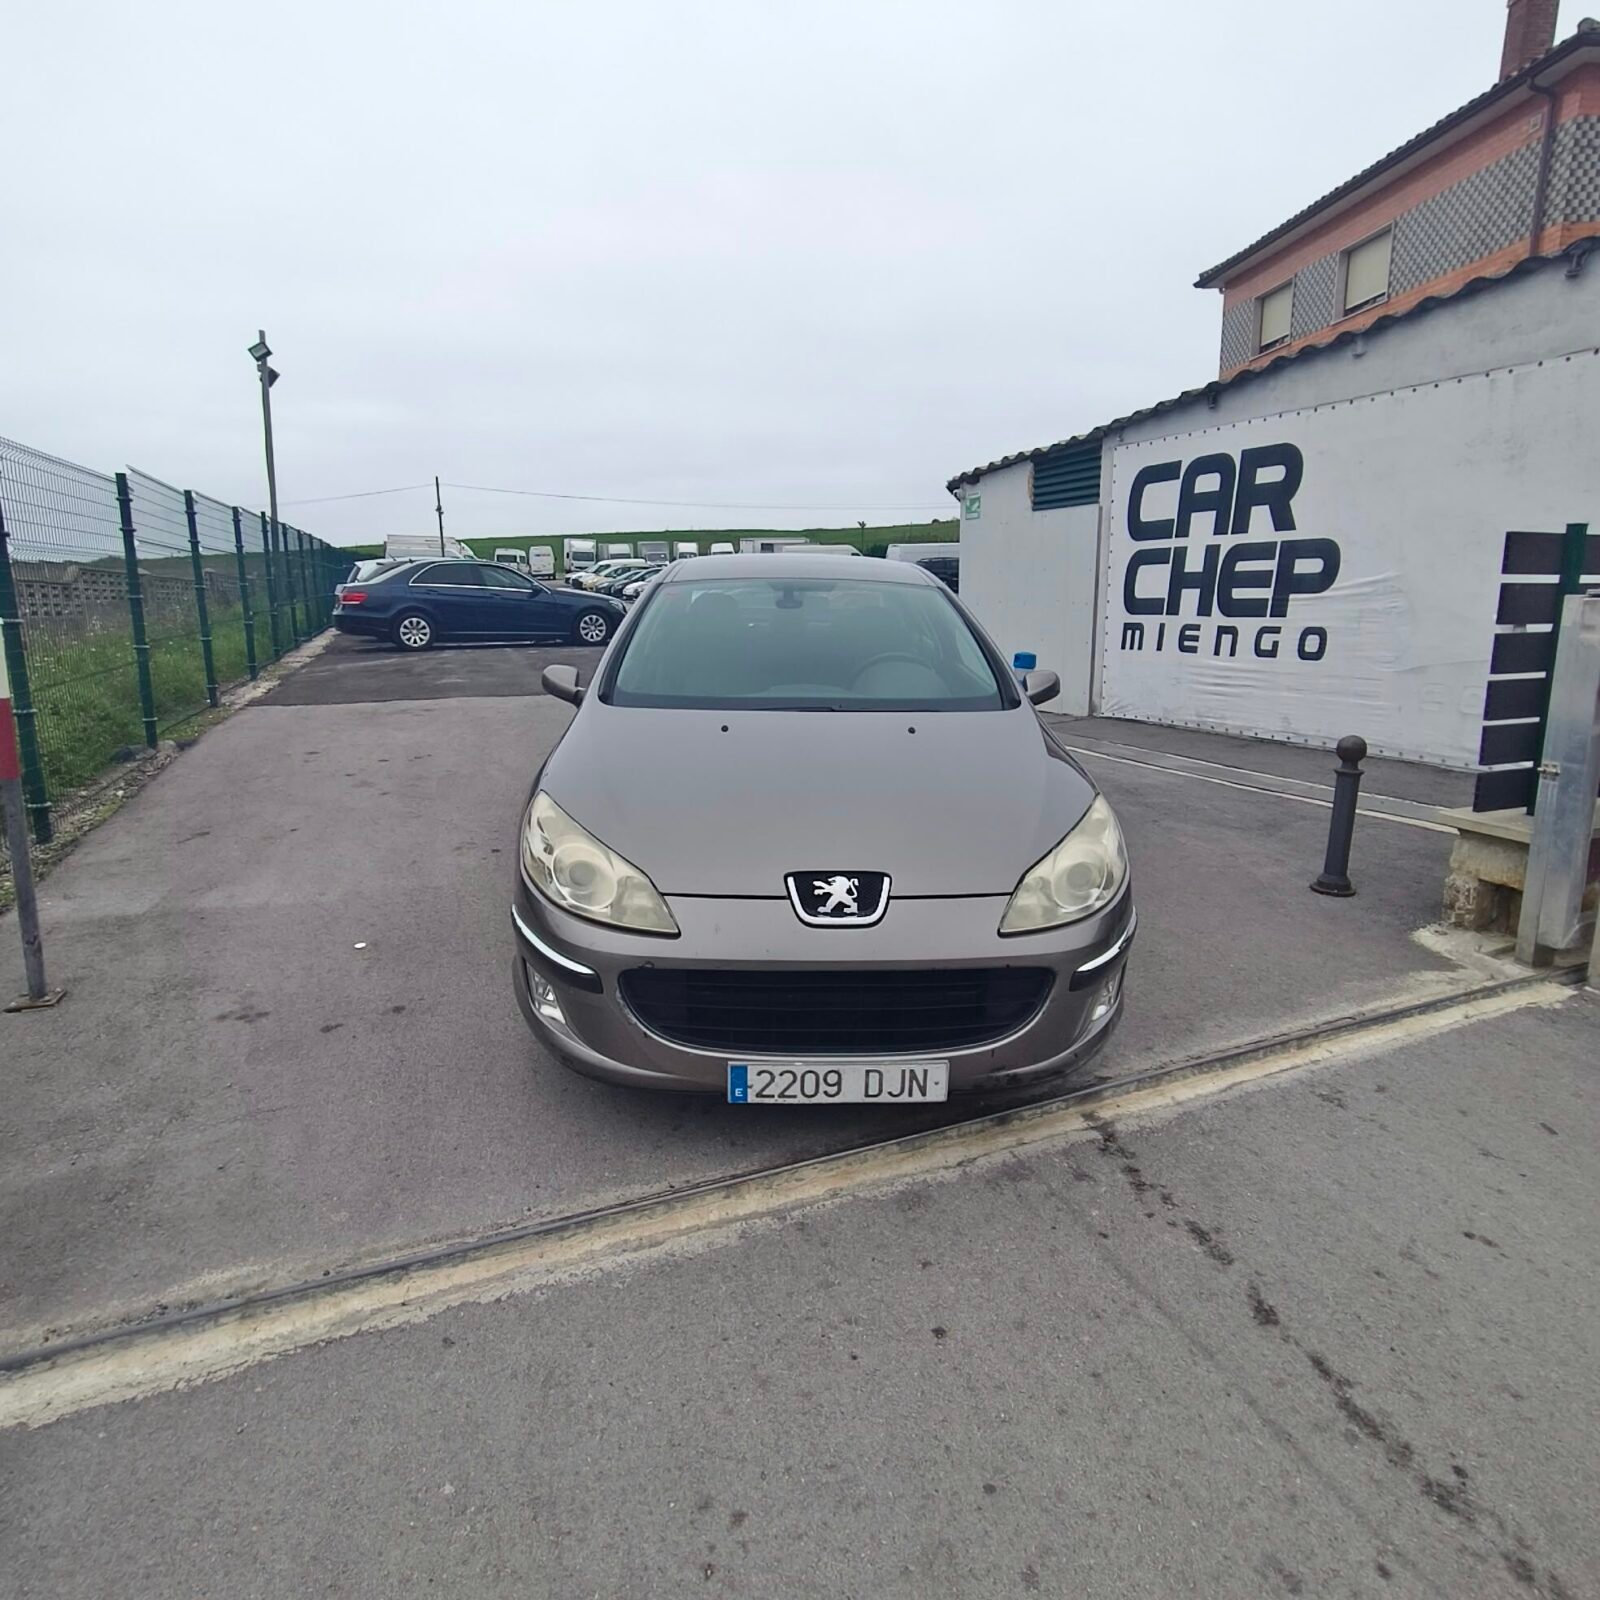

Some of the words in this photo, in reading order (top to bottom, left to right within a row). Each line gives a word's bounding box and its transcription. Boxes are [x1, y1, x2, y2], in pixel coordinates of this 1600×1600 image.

[1127, 442, 1304, 542] CAR
[1123, 537, 1341, 618] CHEP
[1120, 622, 1328, 662] MIENGO
[735, 1088, 743, 1097] E
[754, 1069, 843, 1099] 2209
[863, 1068, 929, 1099] DJN
